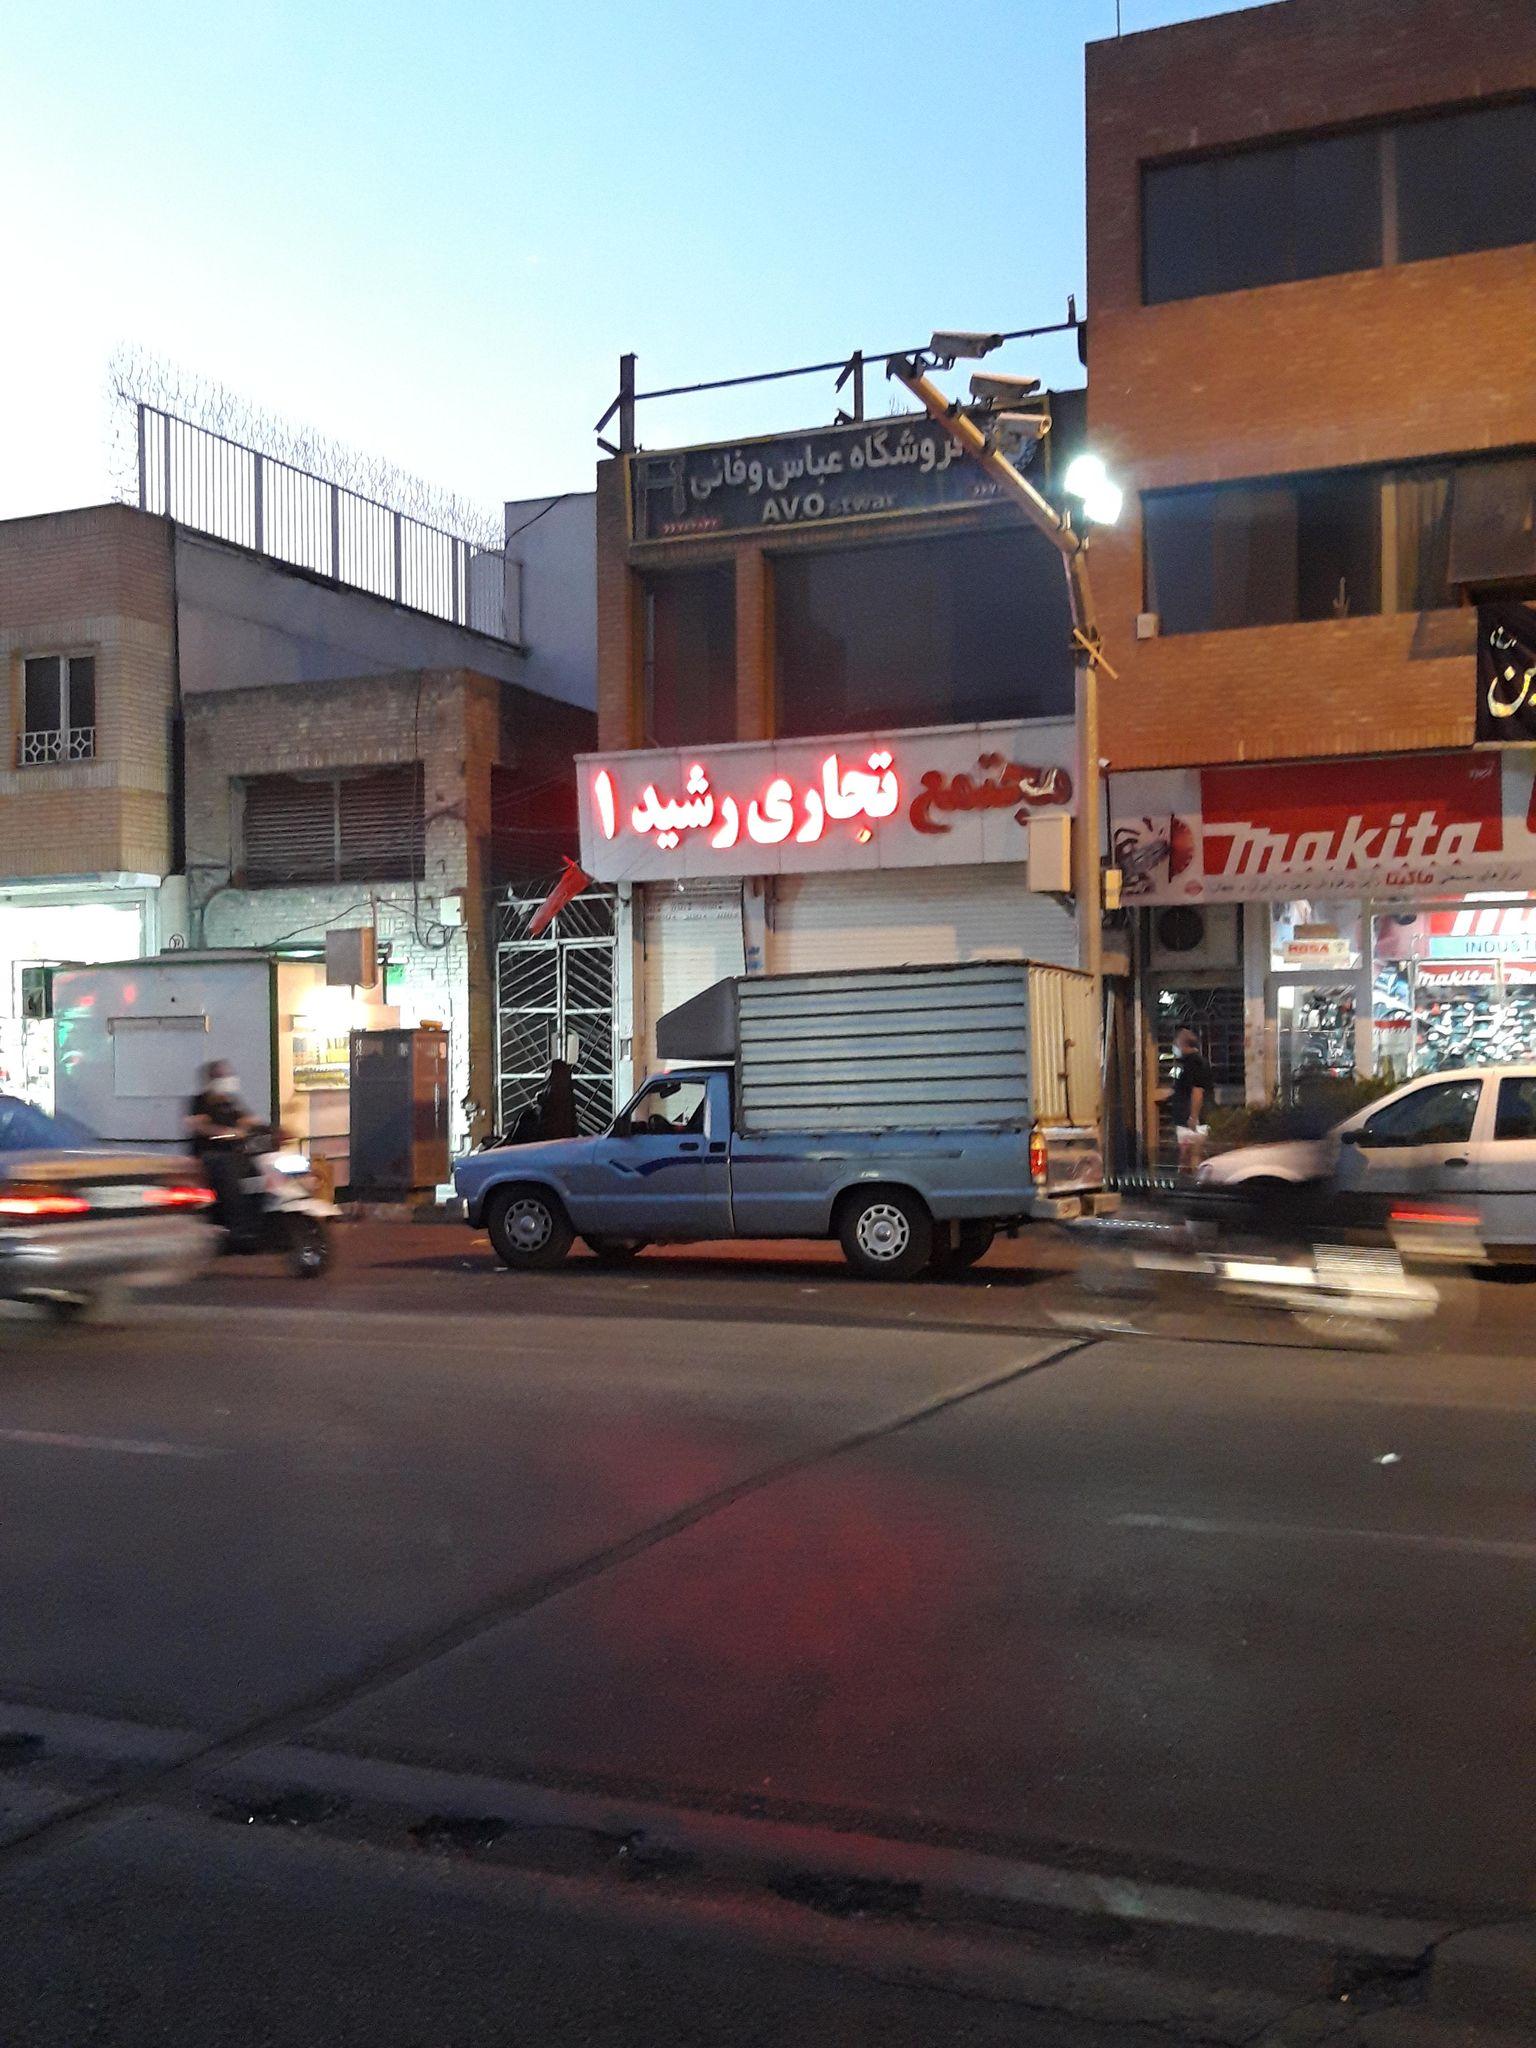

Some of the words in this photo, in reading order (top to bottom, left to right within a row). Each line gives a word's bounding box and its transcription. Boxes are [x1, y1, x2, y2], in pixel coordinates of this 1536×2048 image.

[767, 443, 843, 491] عباس
[632, 763, 740, 850] رشید
[747, 752, 899, 844] تجاری
[909, 752, 1073, 834] مجتمع
